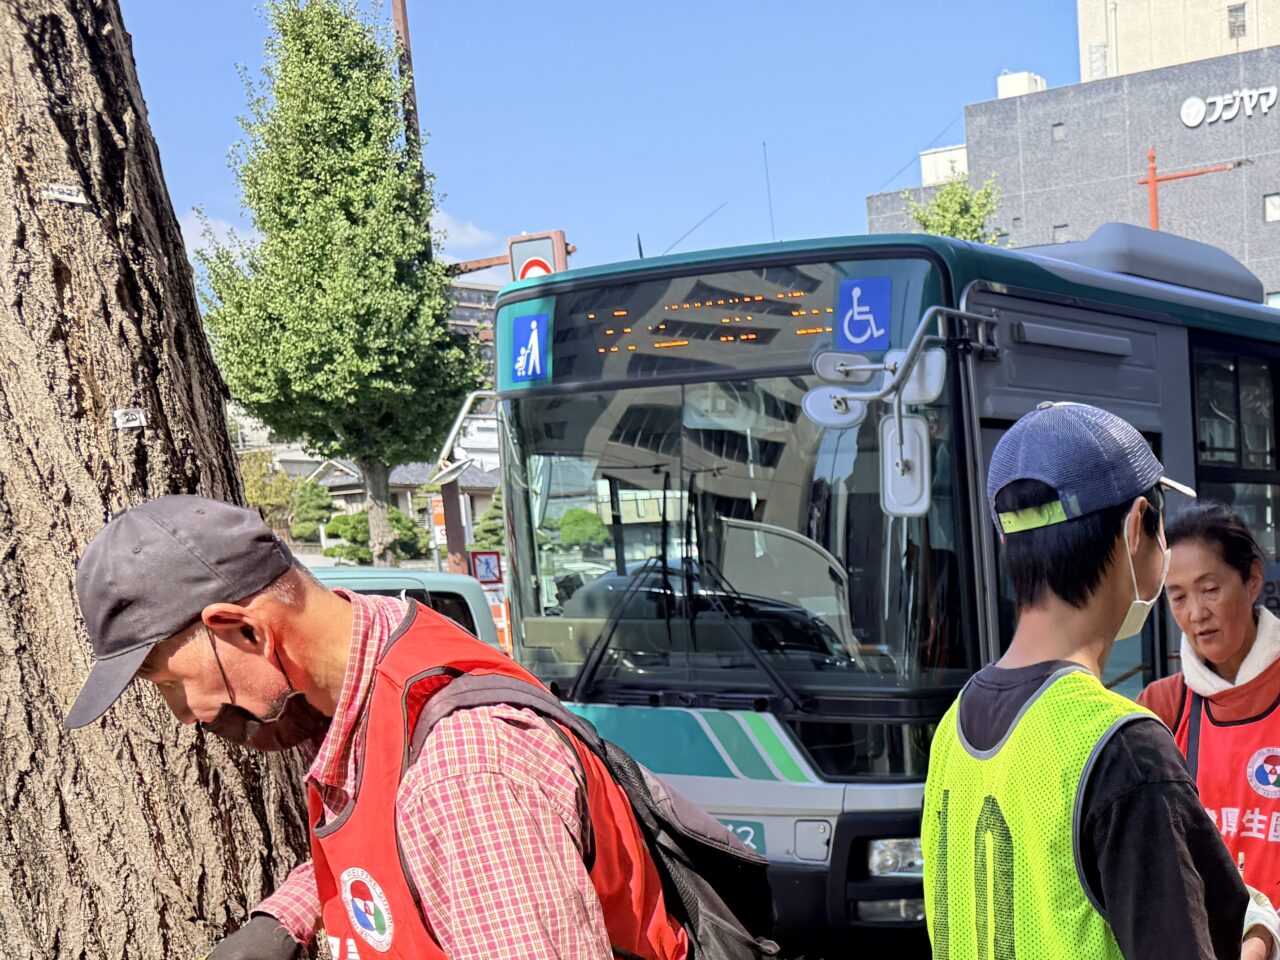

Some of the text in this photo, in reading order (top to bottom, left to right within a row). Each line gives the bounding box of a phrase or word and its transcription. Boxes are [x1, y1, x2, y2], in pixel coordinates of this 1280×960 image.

[1205, 85, 1278, 124] フジヤマ
[728, 824, 757, 849] 2
